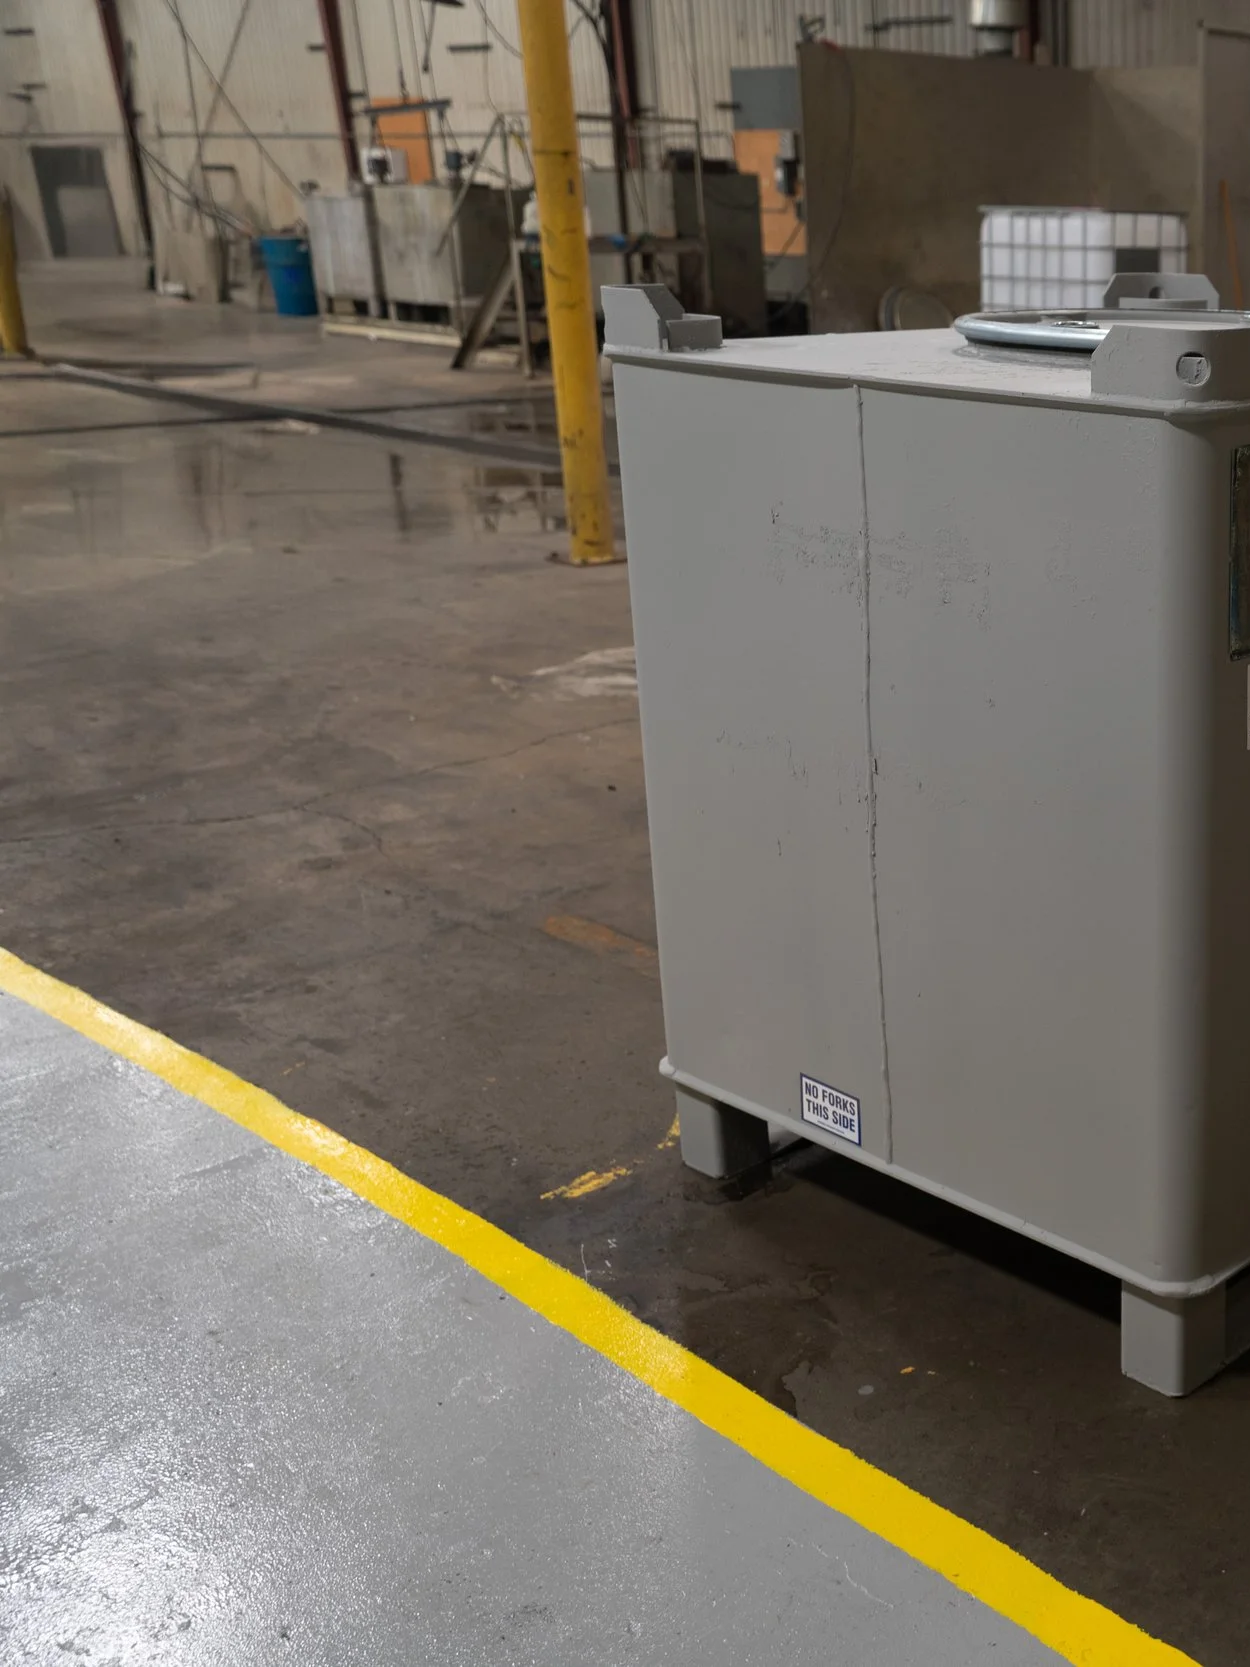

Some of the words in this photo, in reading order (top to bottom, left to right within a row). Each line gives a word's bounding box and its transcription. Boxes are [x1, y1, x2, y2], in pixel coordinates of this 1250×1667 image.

[805, 1081, 818, 1099] NO
[822, 1089, 856, 1116] FORKS
[806, 1098, 829, 1121] THIS
[832, 1110, 856, 1133] SIDE
